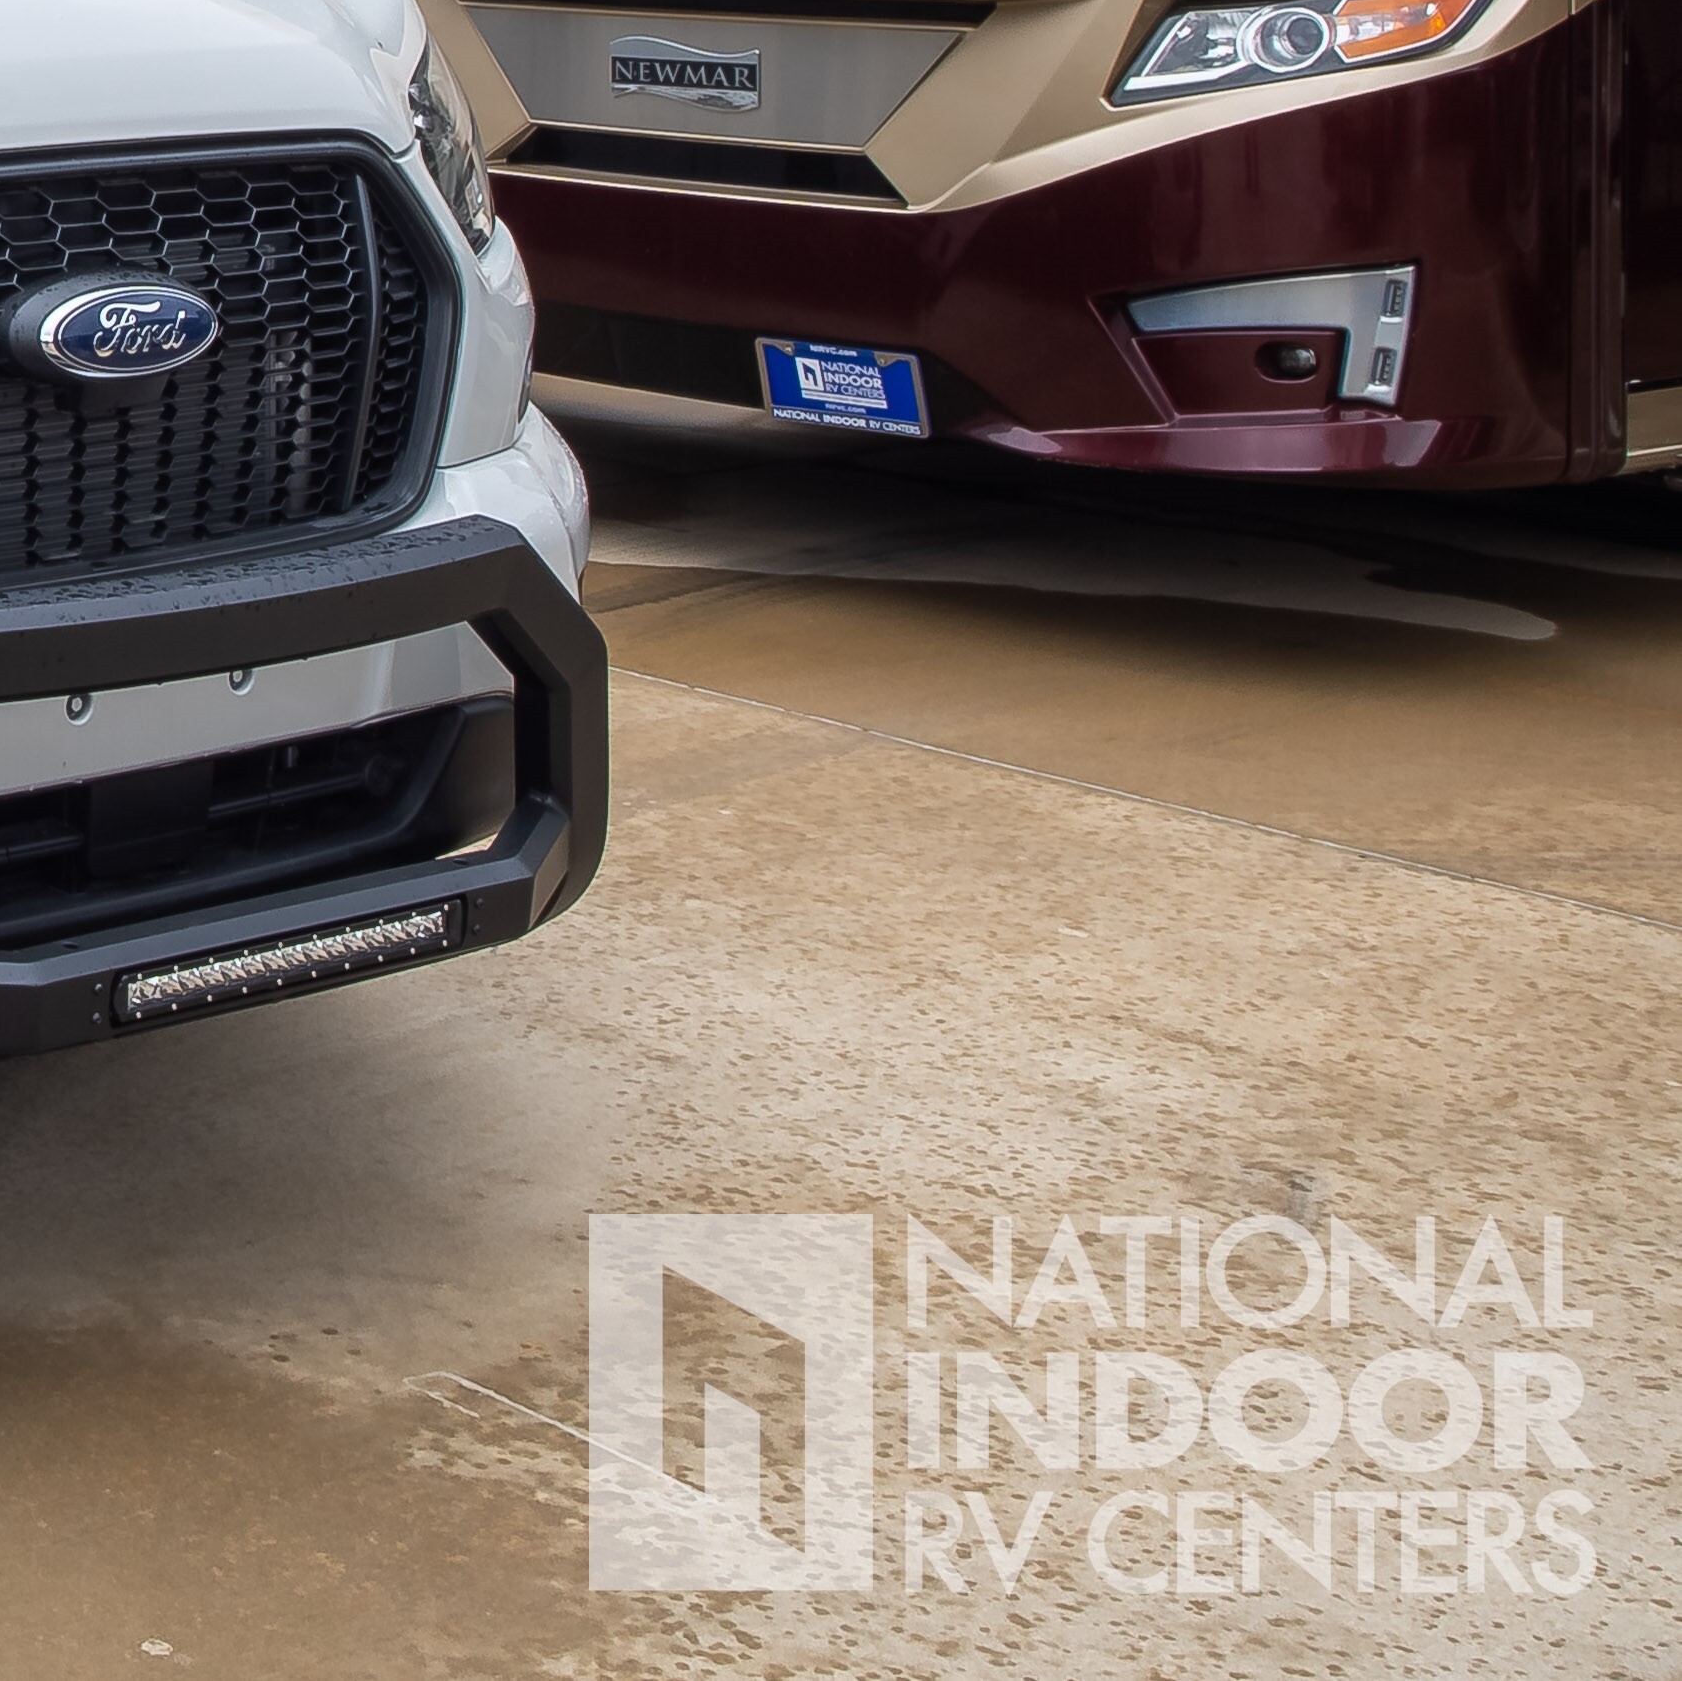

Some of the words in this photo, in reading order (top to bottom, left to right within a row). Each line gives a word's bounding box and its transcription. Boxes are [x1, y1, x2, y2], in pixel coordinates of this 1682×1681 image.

[614, 60, 754, 88] NEWMAR
[93, 301, 187, 358] Ford
[820, 361, 882, 378] NATIONAL
[824, 372, 883, 389] INDOOR
[825, 384, 838, 393] RV
[840, 386, 886, 400] CENTERS
[773, 408, 821, 423] NATIONAL
[823, 413, 867, 428] INDOOR
[869, 419, 880, 429] RV
[882, 422, 921, 435] CENTERS
